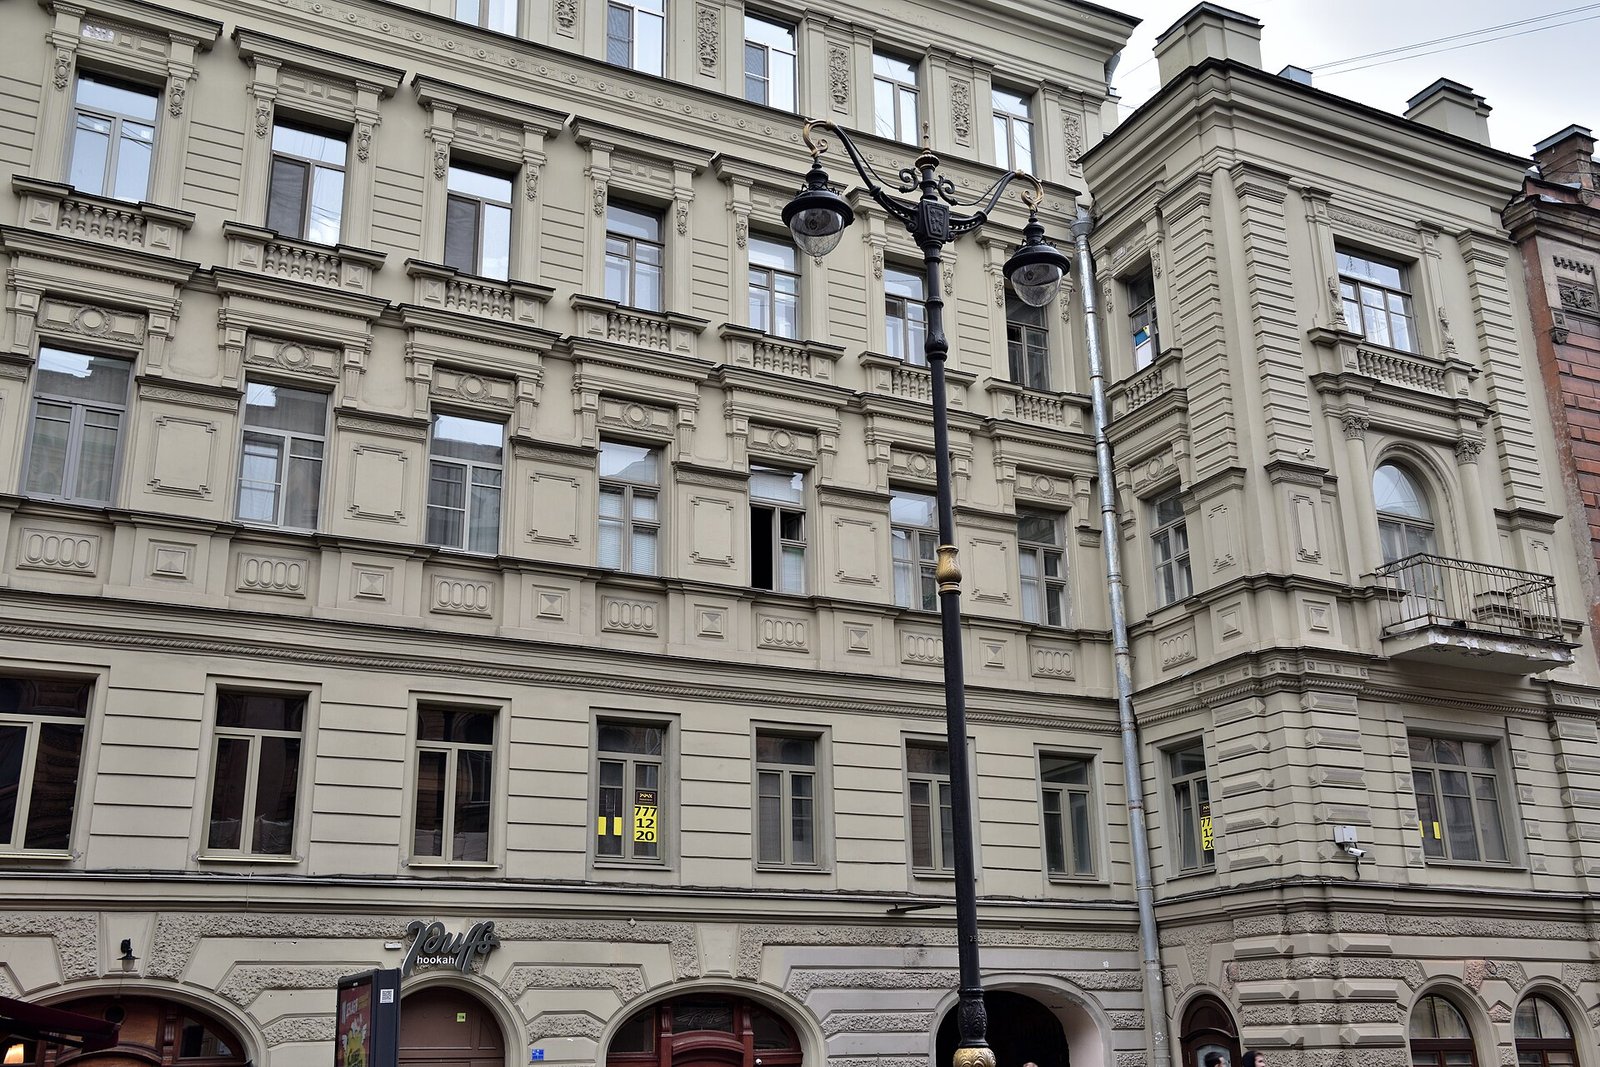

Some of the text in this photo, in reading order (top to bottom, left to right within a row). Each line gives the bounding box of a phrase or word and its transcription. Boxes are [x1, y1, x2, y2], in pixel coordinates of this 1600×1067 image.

[635, 806, 657, 817] 777
[637, 818, 655, 829] 12
[636, 830, 655, 841] 20
[401, 920, 501, 977] Puffs
[416, 955, 455, 965] hookah
